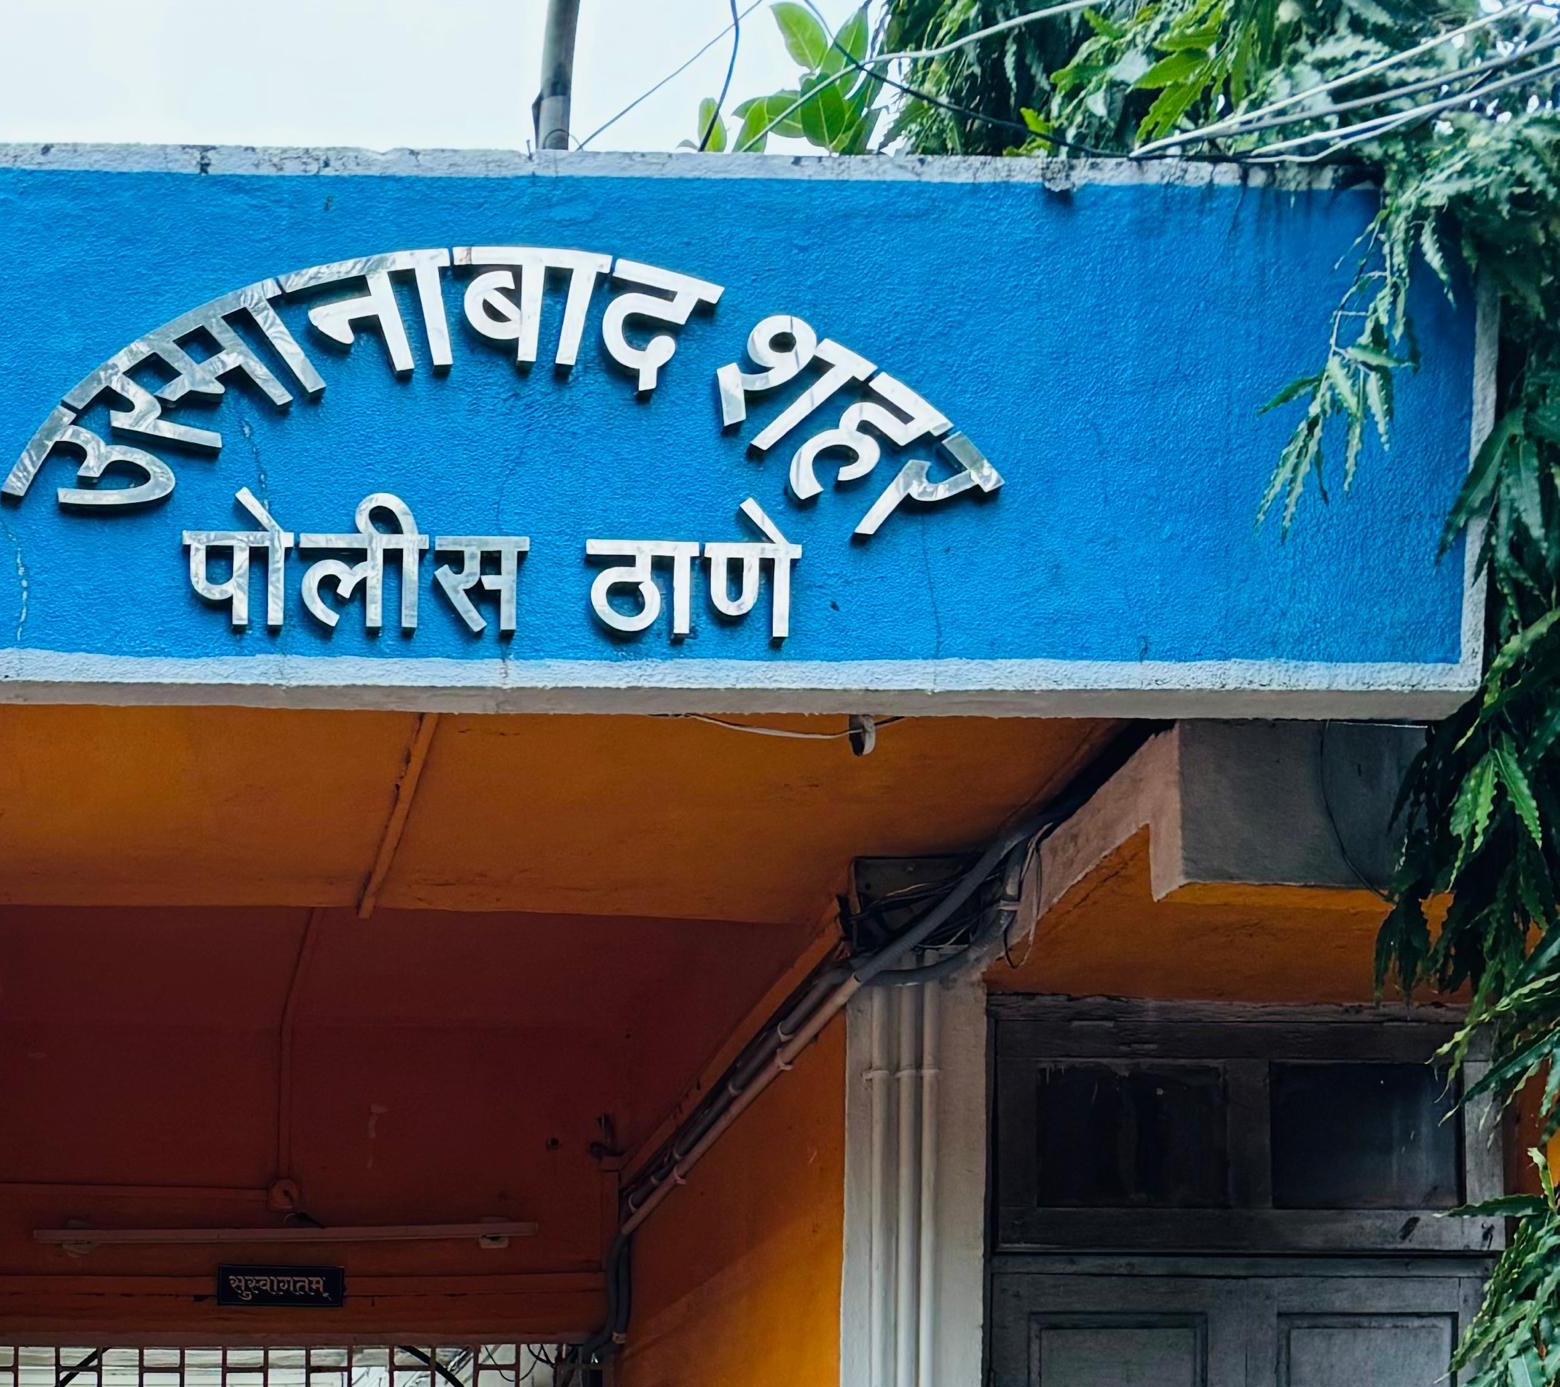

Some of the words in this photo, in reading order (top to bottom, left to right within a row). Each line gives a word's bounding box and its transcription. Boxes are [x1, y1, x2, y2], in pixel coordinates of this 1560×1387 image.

[0, 245, 725, 511] उस्मानाबाद
[714, 314, 1004, 539] शहर
[181, 487, 529, 635] पोलीस
[585, 499, 802, 644] ठाणे
